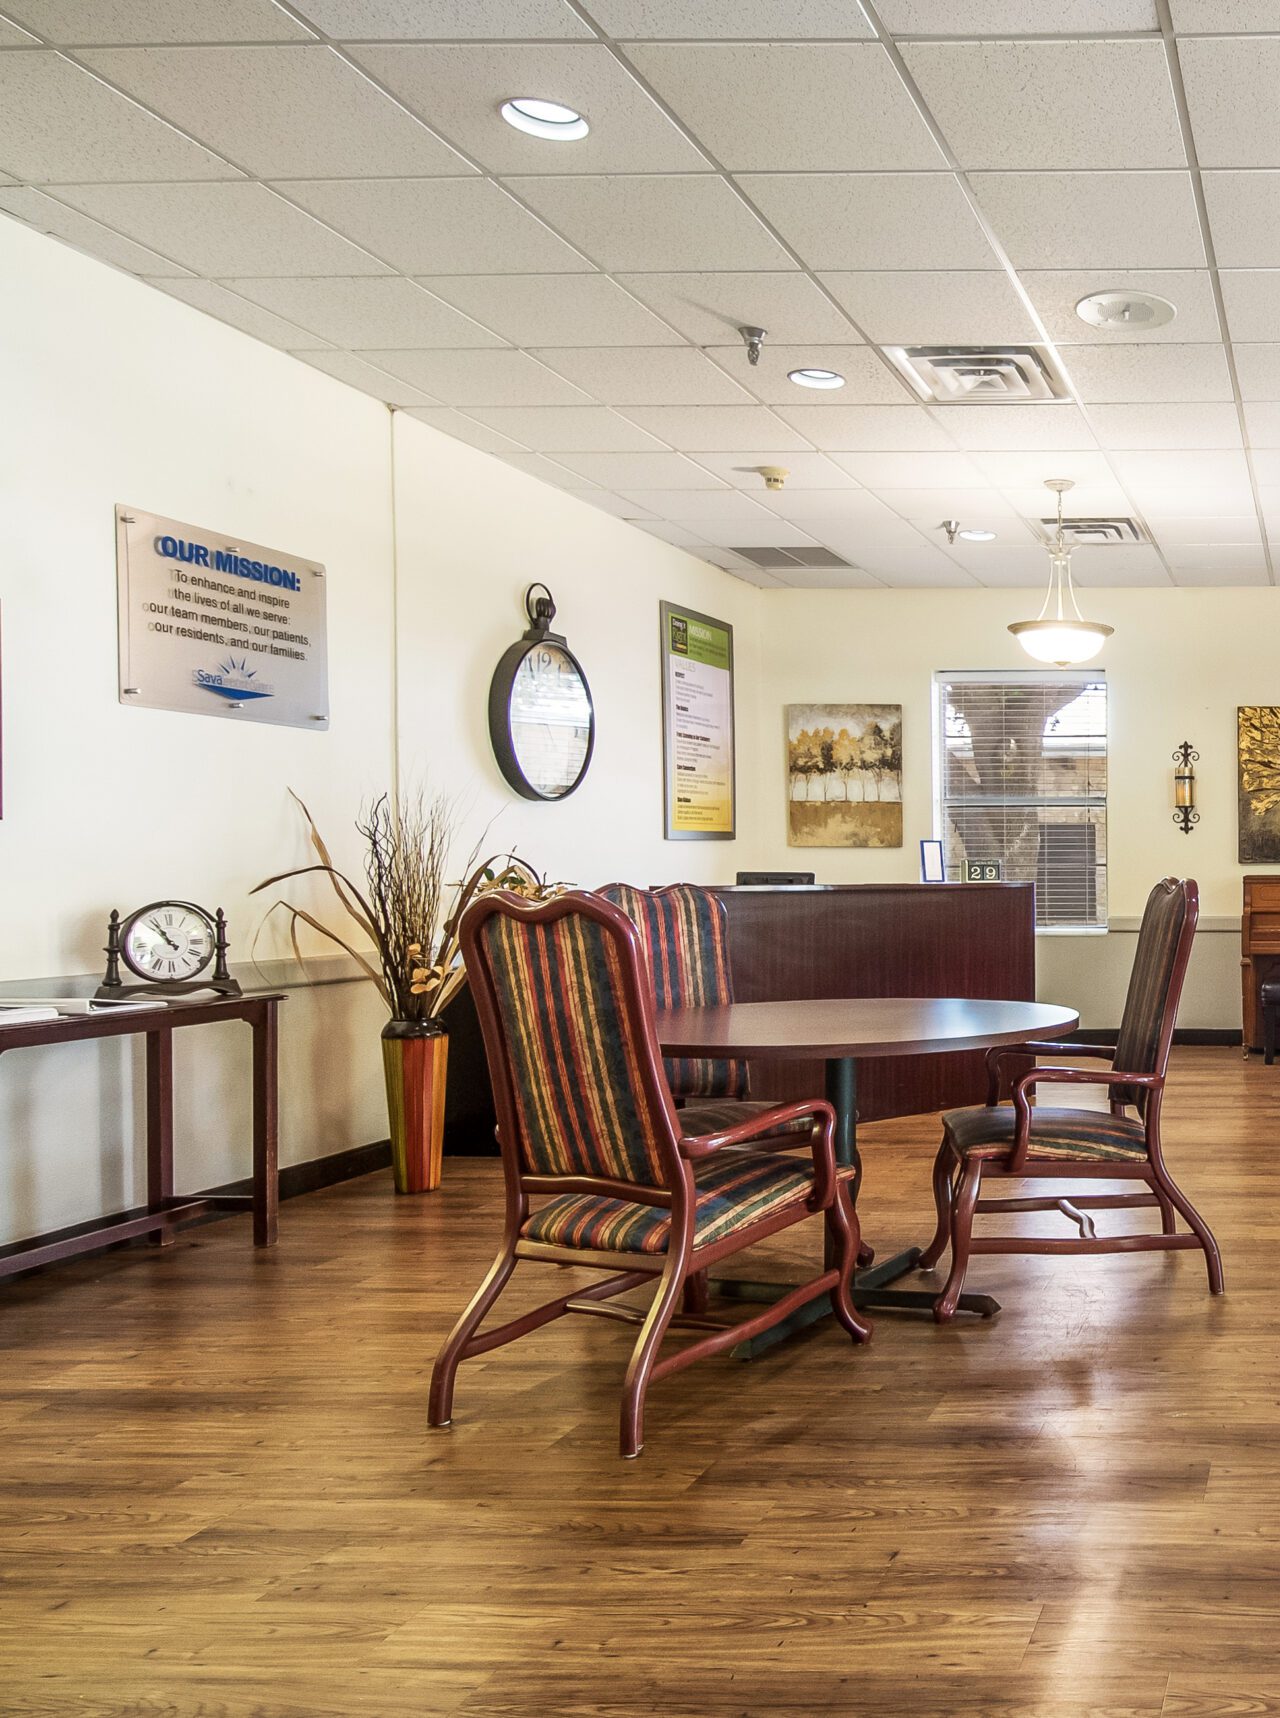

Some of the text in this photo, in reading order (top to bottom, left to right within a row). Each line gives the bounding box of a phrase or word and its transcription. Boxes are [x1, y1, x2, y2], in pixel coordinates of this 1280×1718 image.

[161, 536, 301, 592] OUR MISSION:
[174, 588, 291, 625] the lives of all we serve:
[175, 569, 290, 609] To enhance and inspire
[149, 602, 312, 648] our team members, our patients,
[155, 621, 308, 662] our residents, and our families.
